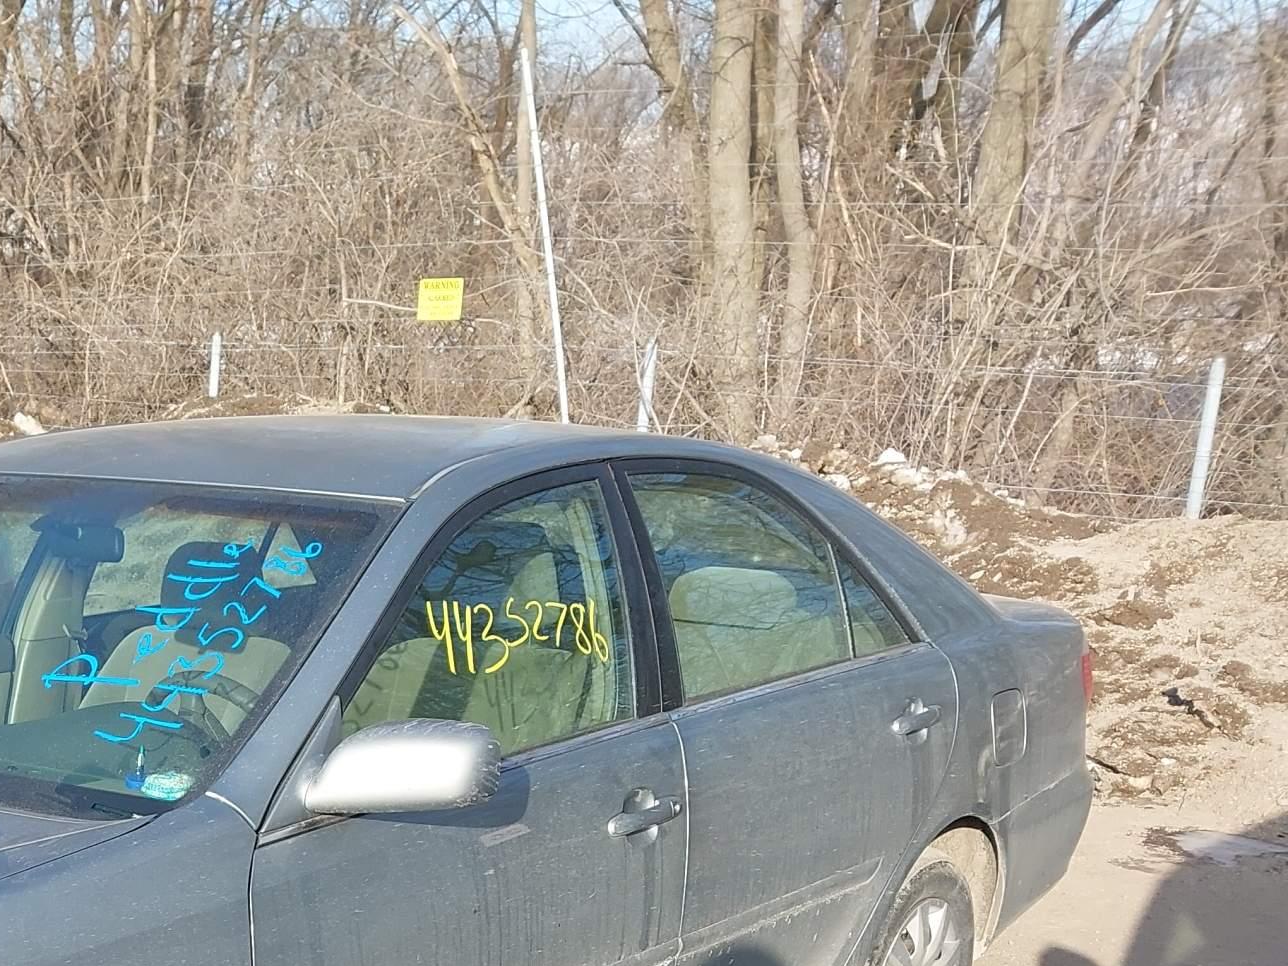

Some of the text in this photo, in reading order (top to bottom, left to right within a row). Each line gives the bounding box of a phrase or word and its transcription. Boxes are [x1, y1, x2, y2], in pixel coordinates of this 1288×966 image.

[423, 280, 459, 290] WARNING
[93, 541, 324, 743] 44352786
[425, 597, 610, 675] 44352786
